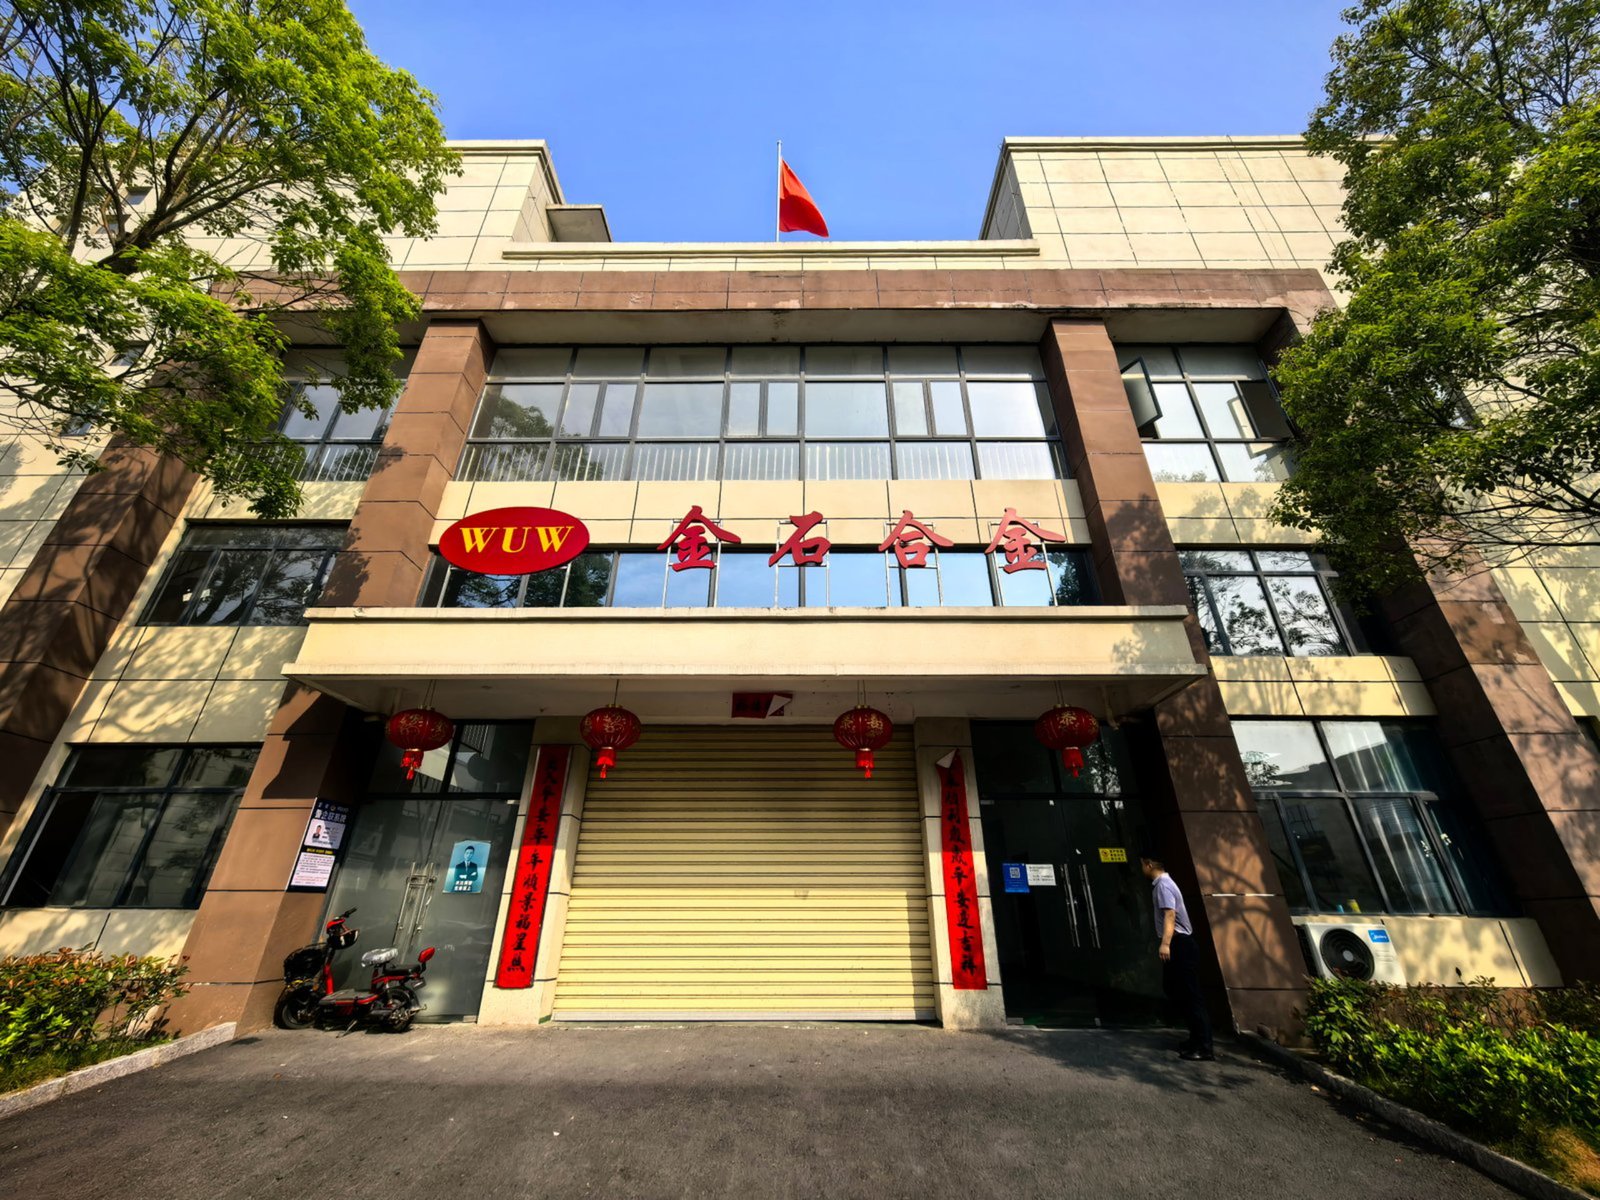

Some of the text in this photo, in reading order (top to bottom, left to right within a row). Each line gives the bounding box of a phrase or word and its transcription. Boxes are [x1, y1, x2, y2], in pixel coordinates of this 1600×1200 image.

[459, 526, 575, 553] WUW
[657, 505, 1066, 574] 金石合金
